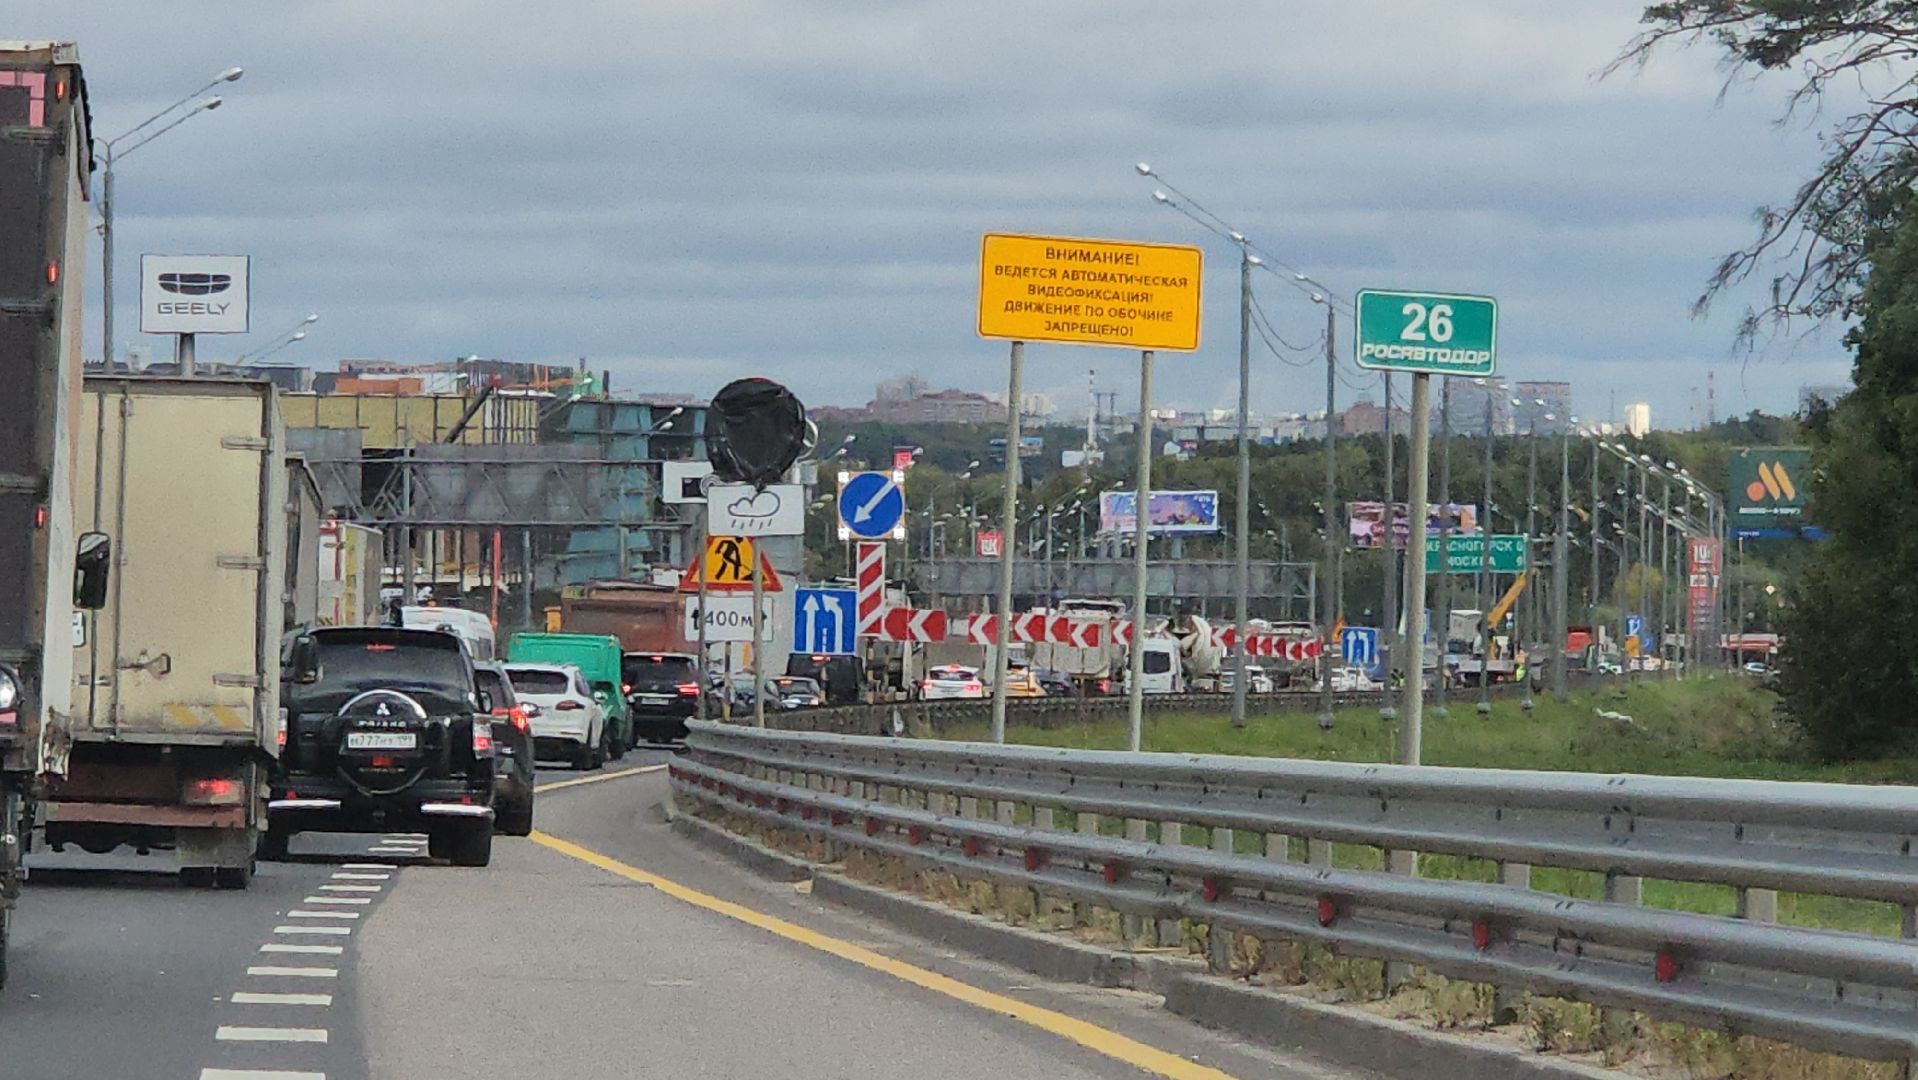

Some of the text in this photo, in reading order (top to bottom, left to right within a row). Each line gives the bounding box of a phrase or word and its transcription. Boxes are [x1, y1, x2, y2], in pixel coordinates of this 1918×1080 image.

[1045, 247, 1140, 266] ВНИМАНИЕ!
[994, 265, 1188, 288] ВЕДЕТСЯ АВТОМАТИЧЕСКАЯ
[1027, 284, 1154, 303] ВИДЕОФИКСАЦИЯ!
[157, 302, 231, 315] GEELY
[1003, 300, 1174, 322] ДВИЖЕНИЕ ПО ОБОЧИНЕ
[1044, 320, 1134, 336] ЗАПРЕЩЕНО!
[1400, 302, 1454, 342] 26
[1361, 343, 1491, 365] РОСАВТОДОР
